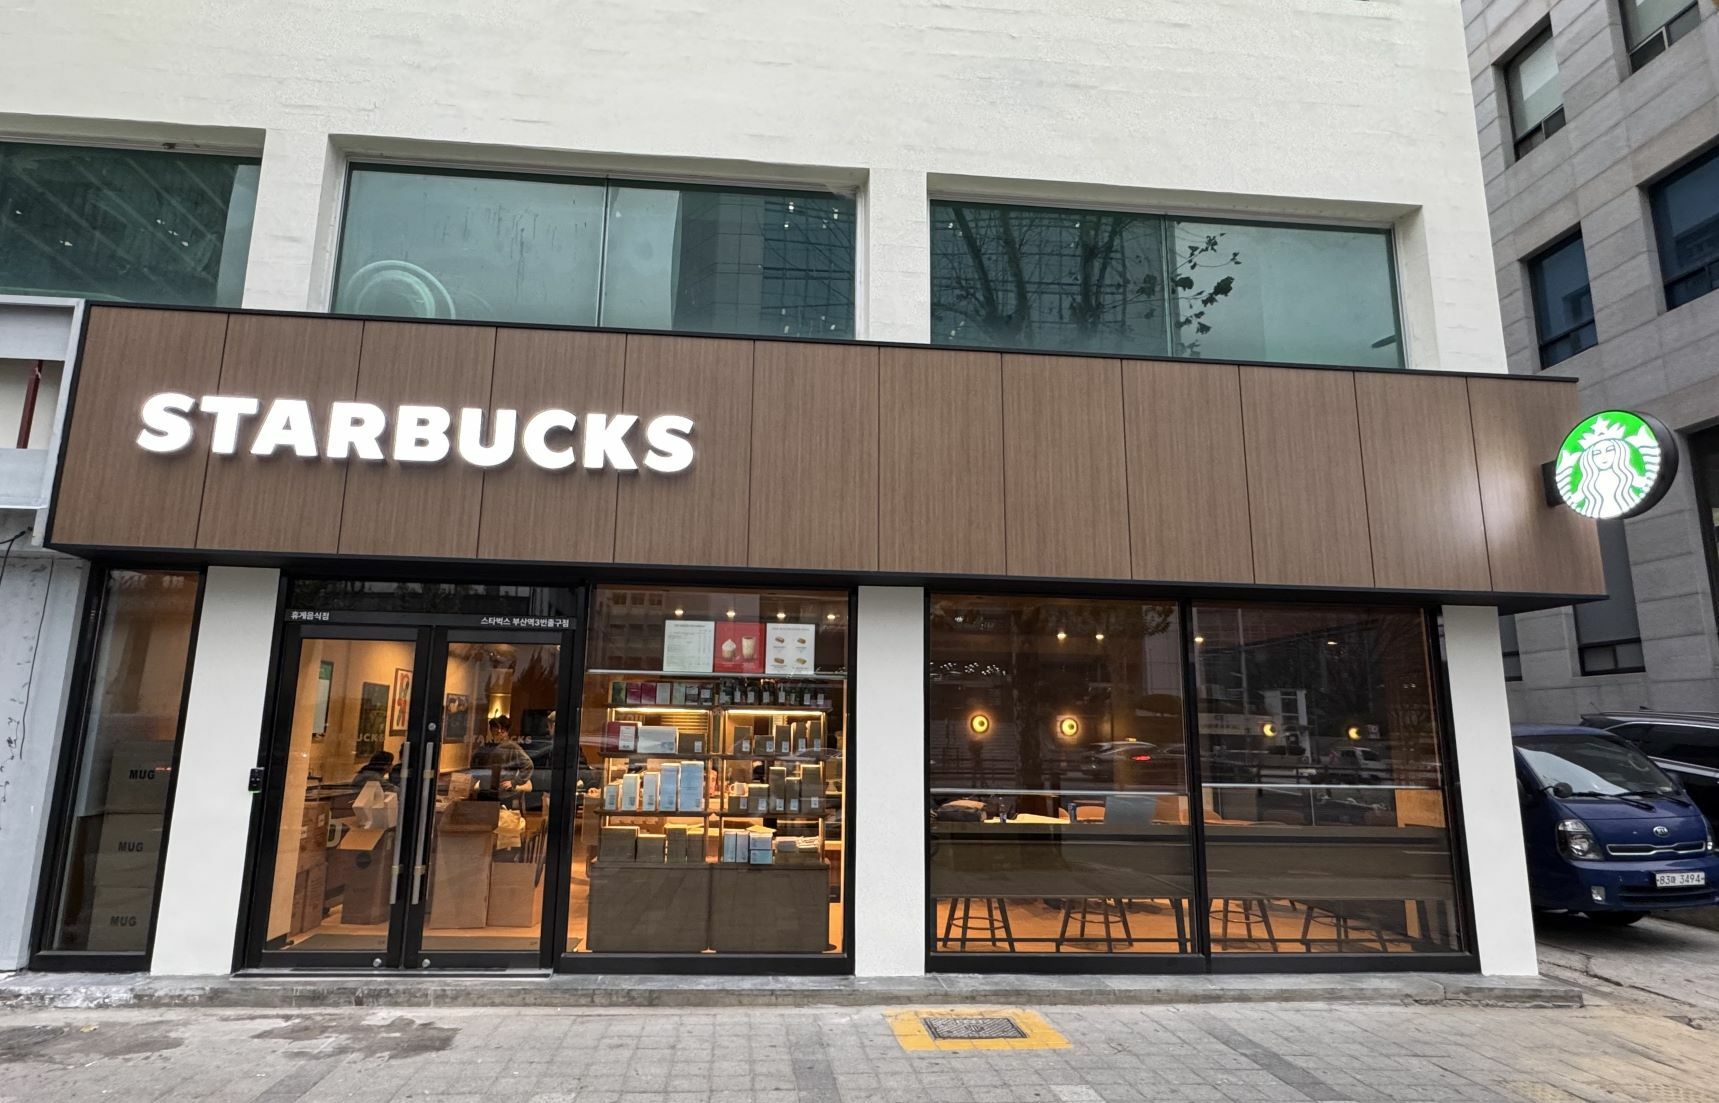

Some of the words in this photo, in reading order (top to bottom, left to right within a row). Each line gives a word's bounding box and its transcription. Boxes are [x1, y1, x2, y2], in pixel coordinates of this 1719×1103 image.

[135, 392, 695, 473] STARBUCKS
[290, 611, 330, 621] 휴게음식점
[480, 616, 511, 626] 스타벅스
[512, 617, 570, 628] 부산역3번출구점
[128, 769, 156, 780] MUG
[118, 841, 144, 852] MUG
[1679, 873, 1701, 884] 3494
[110, 916, 137, 927] MUG
